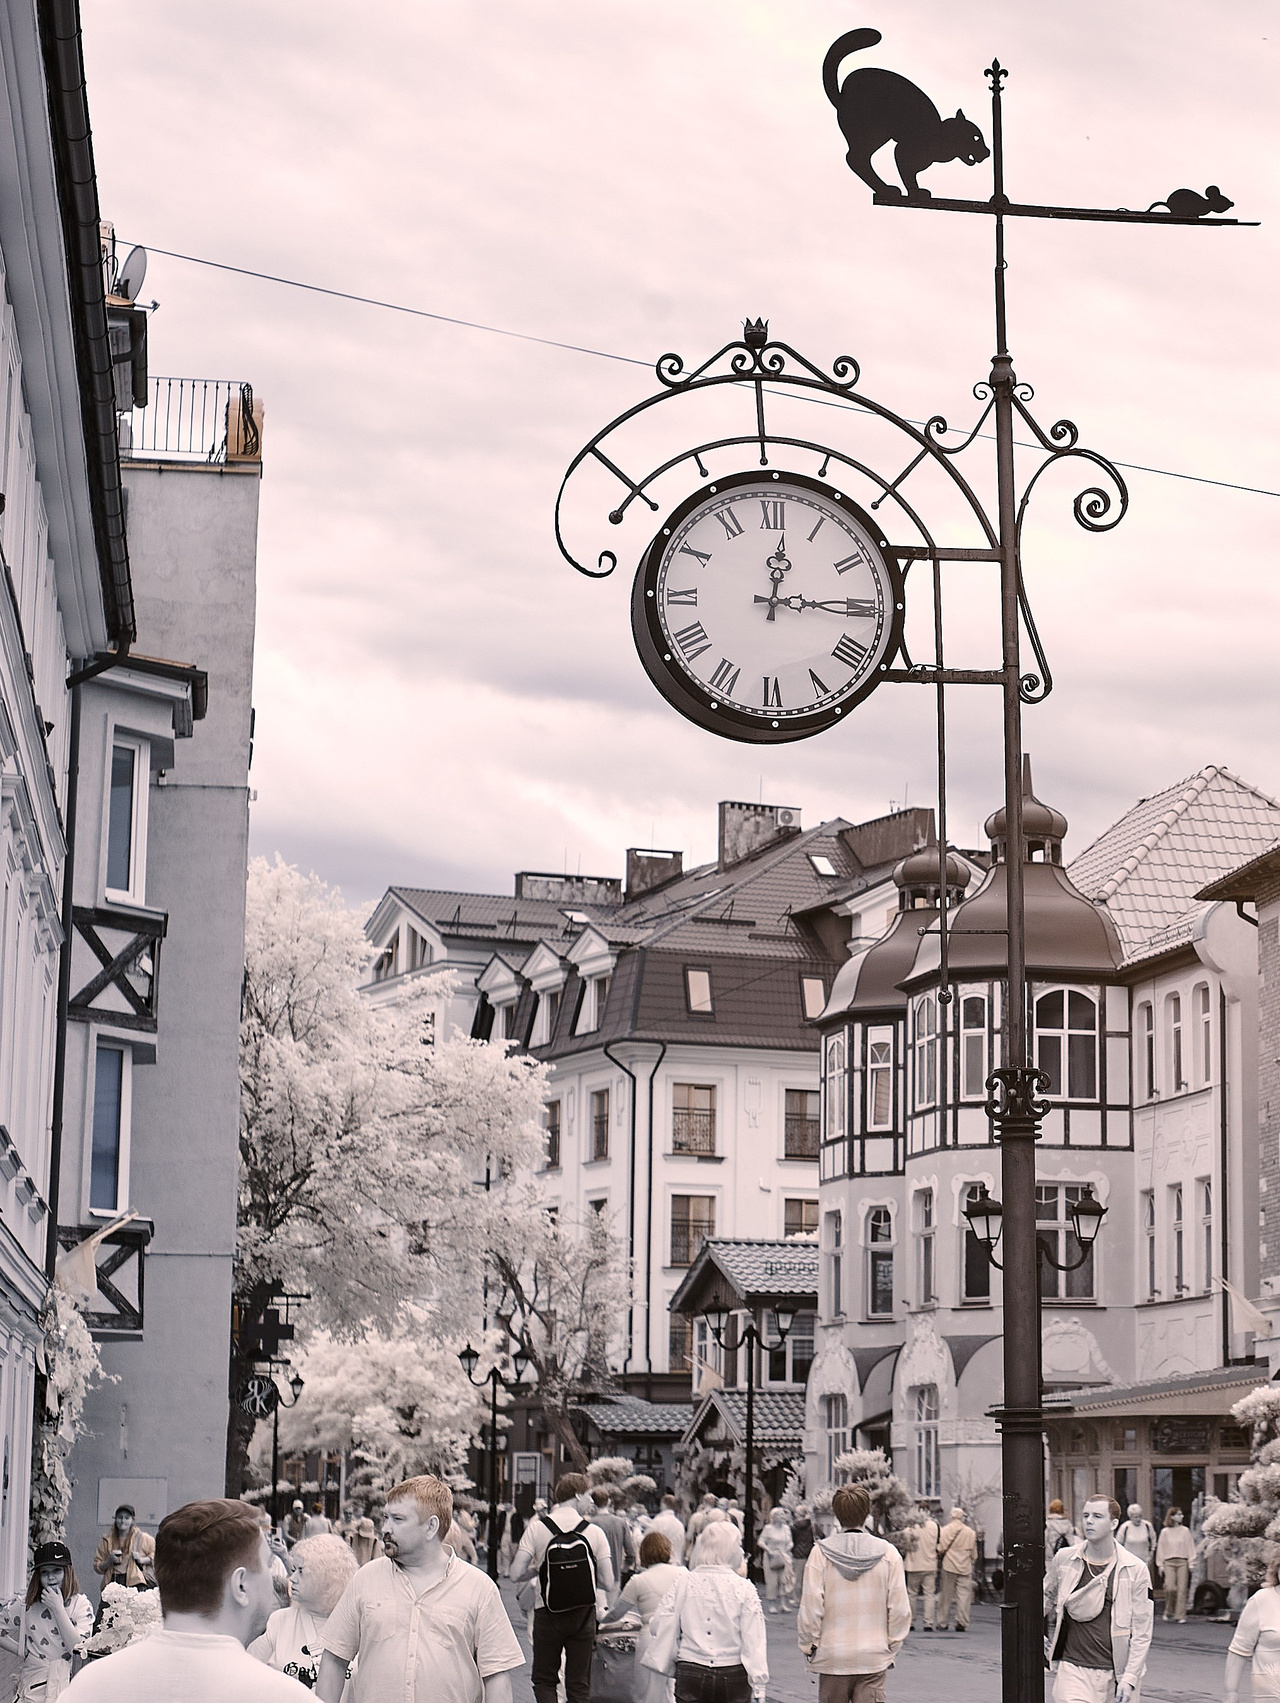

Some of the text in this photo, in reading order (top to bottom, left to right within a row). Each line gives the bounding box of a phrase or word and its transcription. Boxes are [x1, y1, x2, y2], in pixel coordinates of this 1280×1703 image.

[713, 506, 745, 540] XI
[760, 501, 786, 530] XII
[806, 516, 826, 543] I
[678, 540, 712, 567] X
[833, 552, 864, 575] II
[667, 588, 697, 607] IX
[673, 621, 713, 663] VIII
[831, 633, 869, 671] IIII
[707, 658, 741, 697] VII
[762, 677, 783, 707] VI
[809, 668, 831, 699] V
